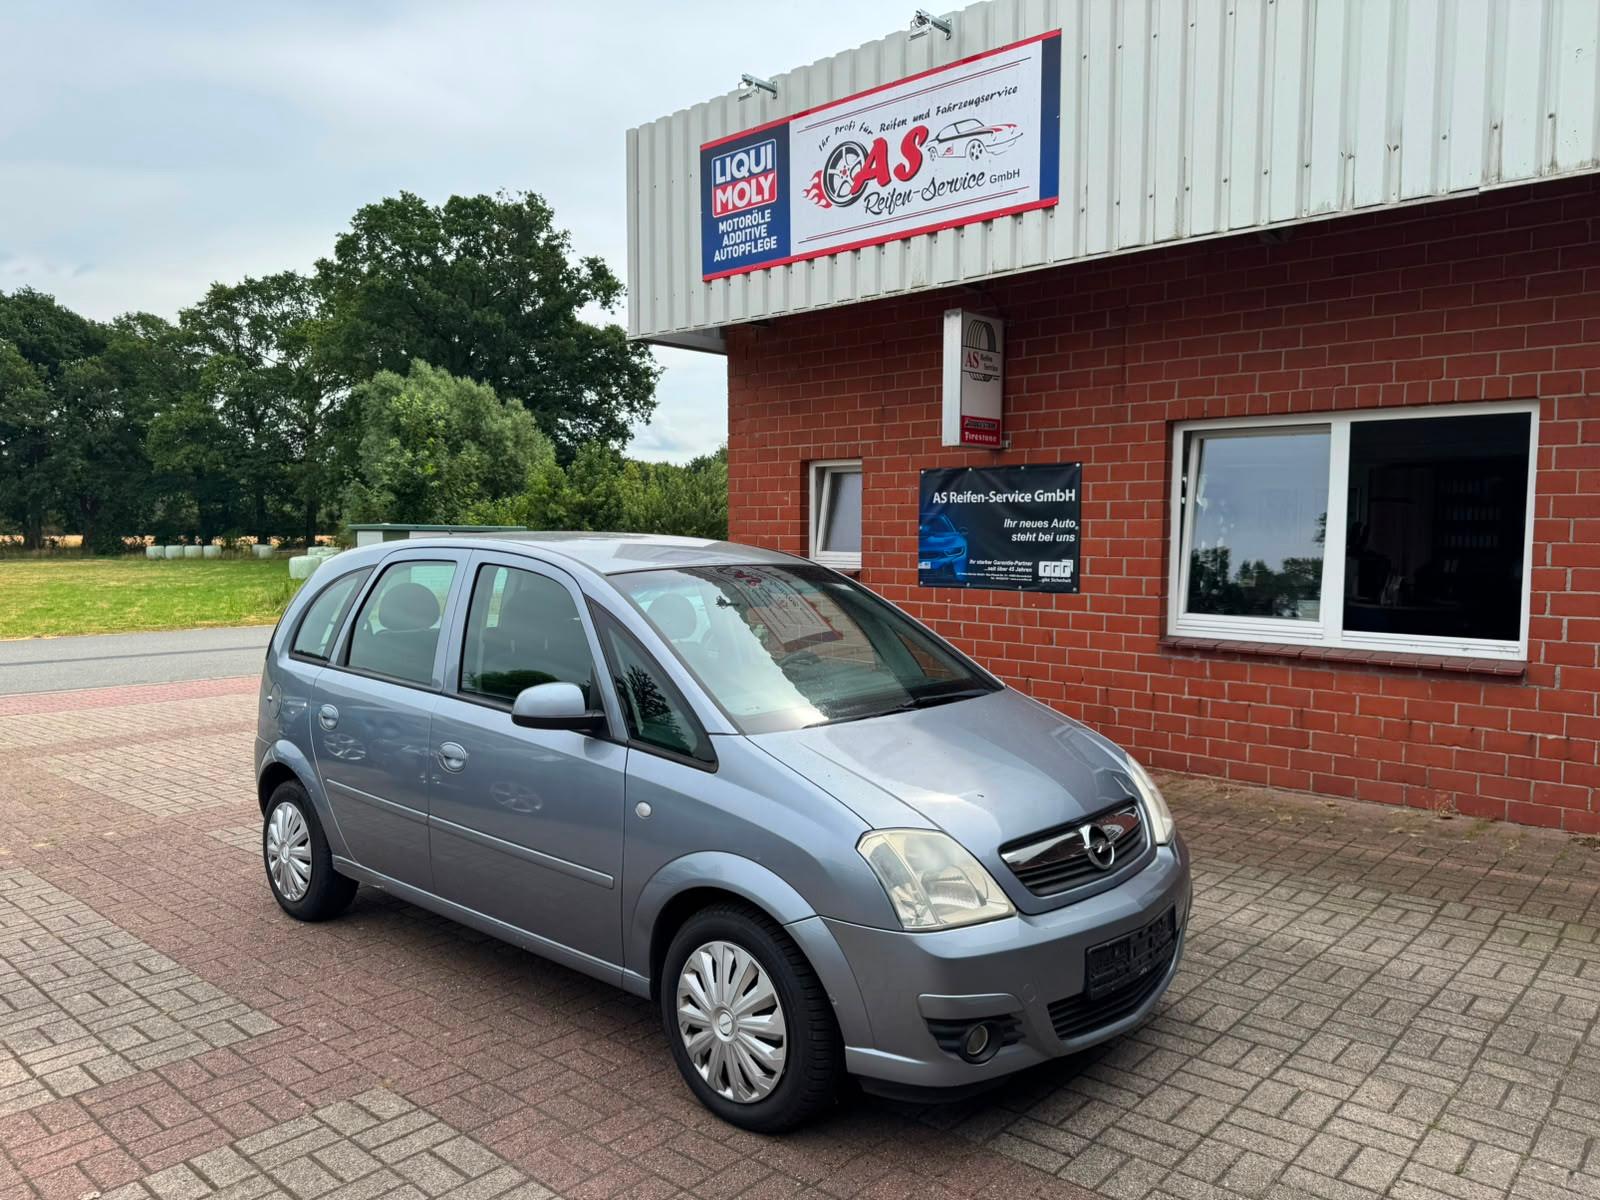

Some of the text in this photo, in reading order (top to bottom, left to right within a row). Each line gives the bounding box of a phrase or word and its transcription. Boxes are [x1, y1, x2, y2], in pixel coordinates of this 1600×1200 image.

[818, 135, 831, 152] Ihr
[858, 121, 874, 135] für
[880, 117, 908, 133] Reifen
[912, 108, 930, 123] und
[935, 85, 1018, 116] Fahrzeugservice
[715, 143, 772, 184] LIQUI
[851, 125, 929, 195] AS
[716, 172, 775, 213] MOLY
[864, 168, 1020, 215] Reifen-Service GmbH
[719, 209, 772, 234] MOTORÖLE
[722, 224, 768, 247] ADDITIVE
[713, 236, 777, 263] AUTOPFLEGE
[965, 351, 979, 369] AS
[932, 489, 1076, 504] AS Reifen-Service GmbH
[1003, 518, 1076, 529] Ihr neues Auto
[1011, 533, 1075, 542] steht bei uns
